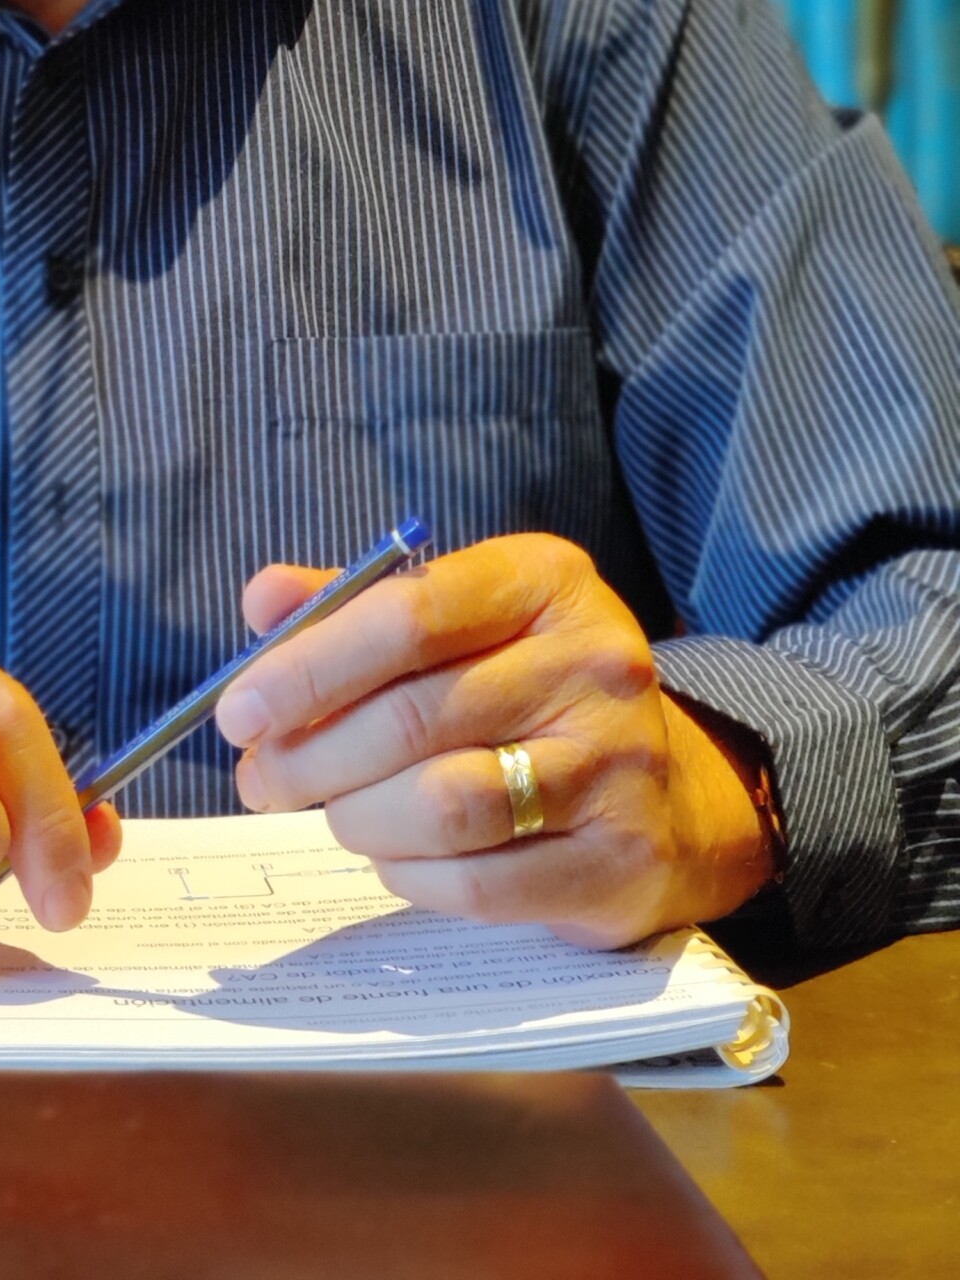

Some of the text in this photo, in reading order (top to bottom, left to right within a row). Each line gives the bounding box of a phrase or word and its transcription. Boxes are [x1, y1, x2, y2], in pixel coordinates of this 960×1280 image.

[168, 912, 271, 920] alimentación
[202, 919, 306, 928] alimentación
[480, 953, 557, 965] utilizar
[452, 960, 472, 969] el
[547, 962, 602, 972] utilizar
[228, 973, 278, 982] CA?
[286, 971, 316, 979] de
[426, 970, 513, 983] adaptador
[113, 967, 671, 1007] Conexión de una fuente de alimentación
[248, 984, 319, 992] paquete
